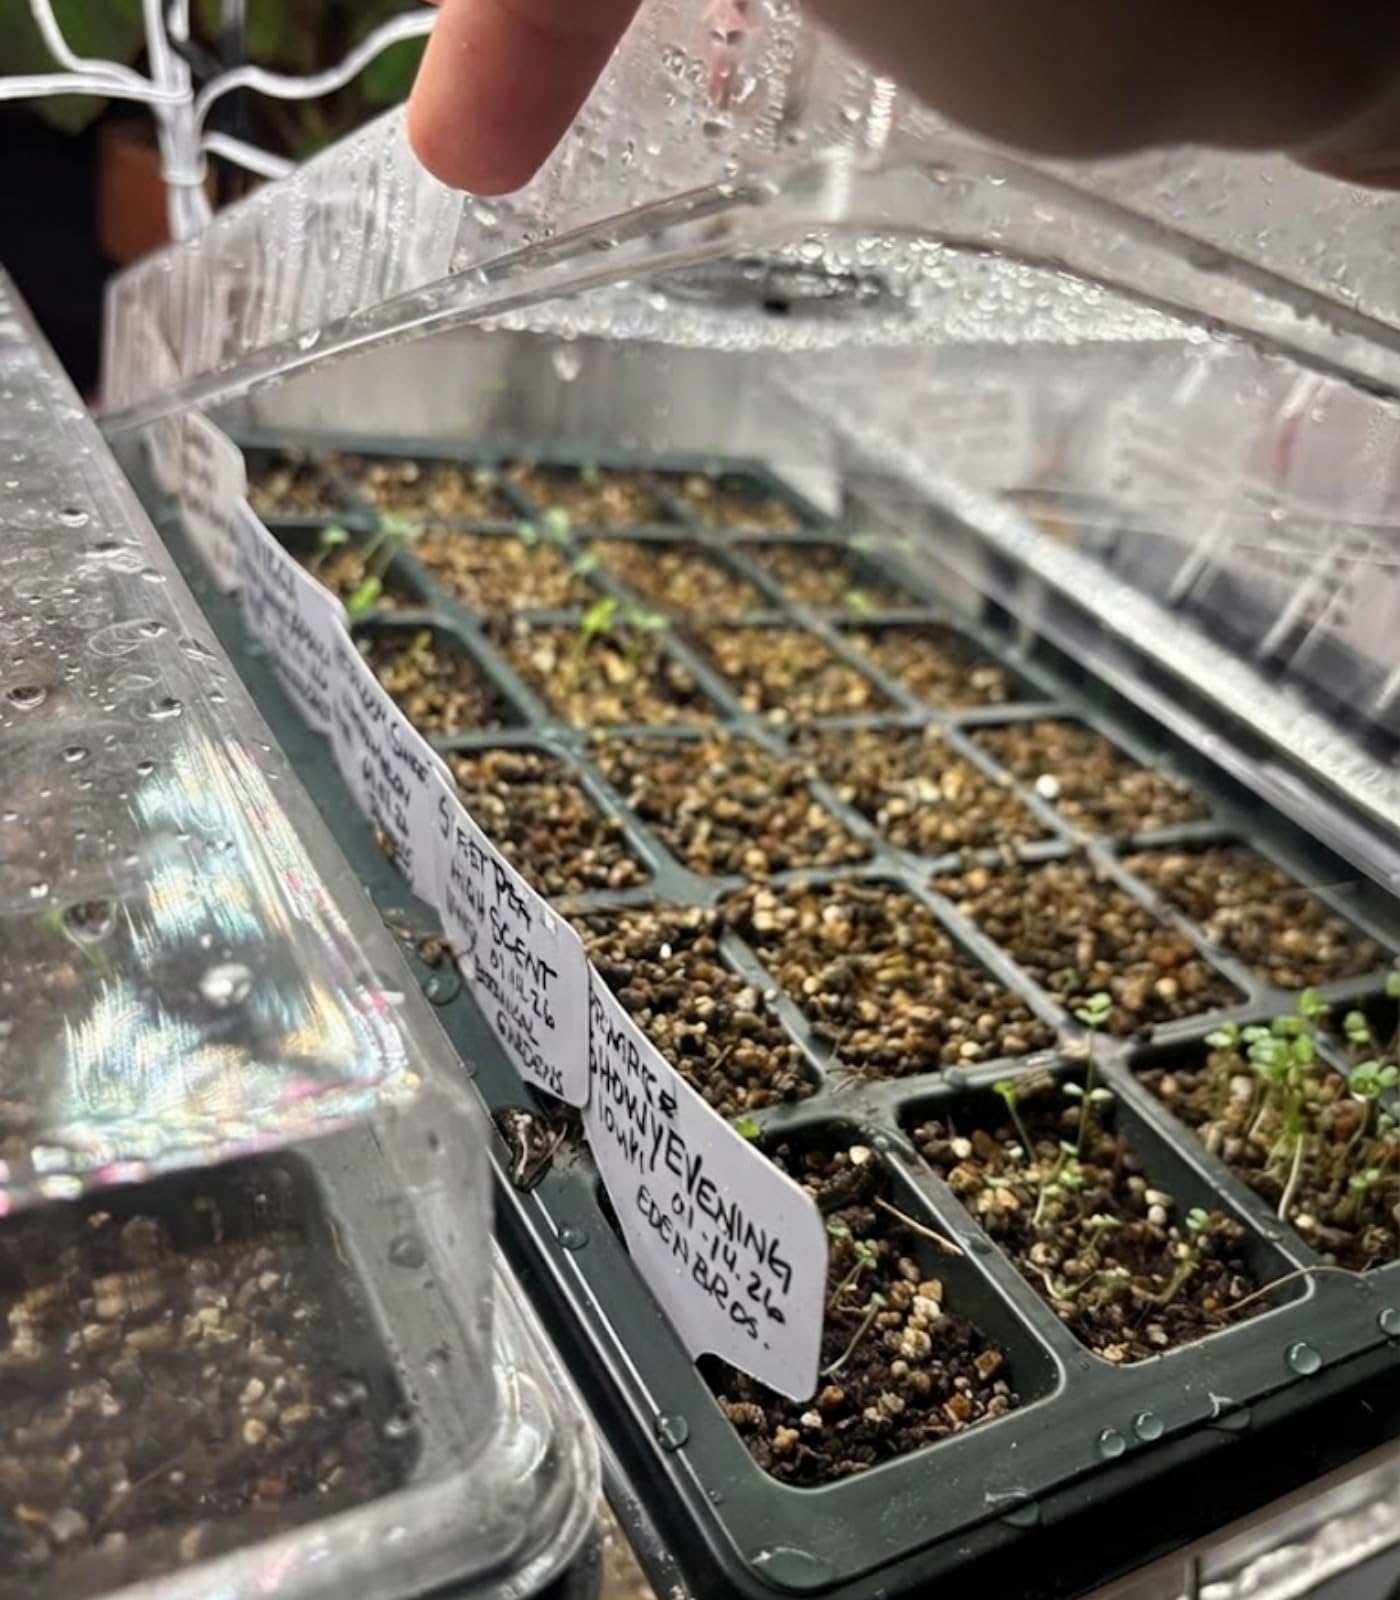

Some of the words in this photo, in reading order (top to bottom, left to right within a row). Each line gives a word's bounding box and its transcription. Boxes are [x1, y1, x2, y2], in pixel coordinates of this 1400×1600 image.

[488, 904, 558, 992] SCENT
[636, 1183, 689, 1267] EDEN
[692, 1254, 771, 1351] BROS.
[663, 1133, 793, 1294] EVENING
